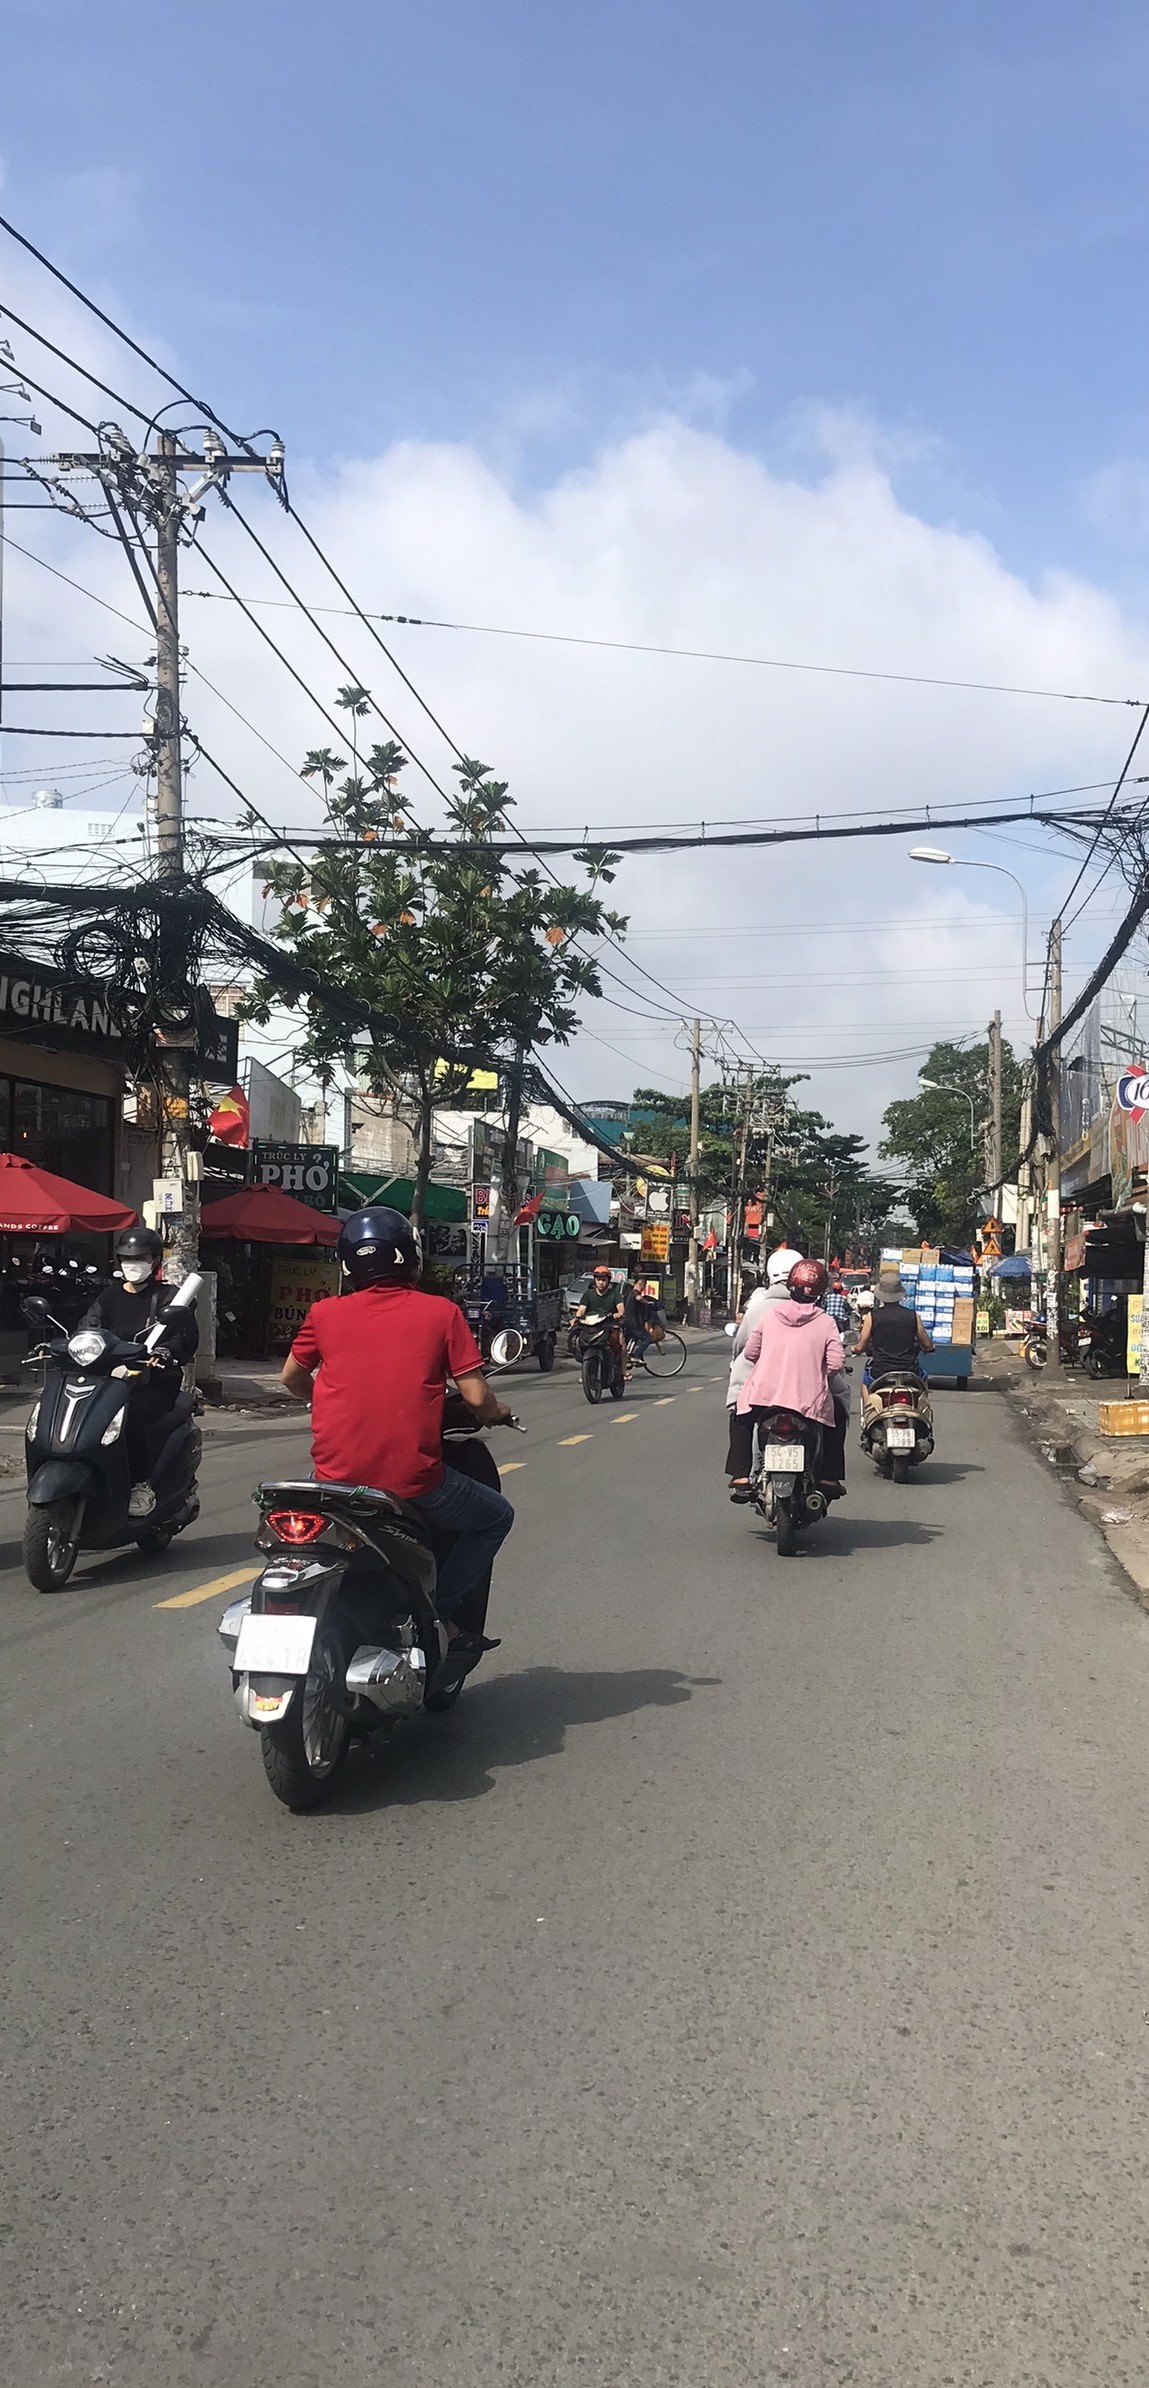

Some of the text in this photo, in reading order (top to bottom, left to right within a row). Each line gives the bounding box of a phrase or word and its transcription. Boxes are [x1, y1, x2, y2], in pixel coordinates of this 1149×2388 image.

[294, 1152, 307, 1161] LY
[260, 1153, 330, 1191] PHỞ
[537, 1213, 580, 1240] GẠO
[771, 1446, 799, 1458] 54-V5
[772, 1459, 799, 1470] 1265
